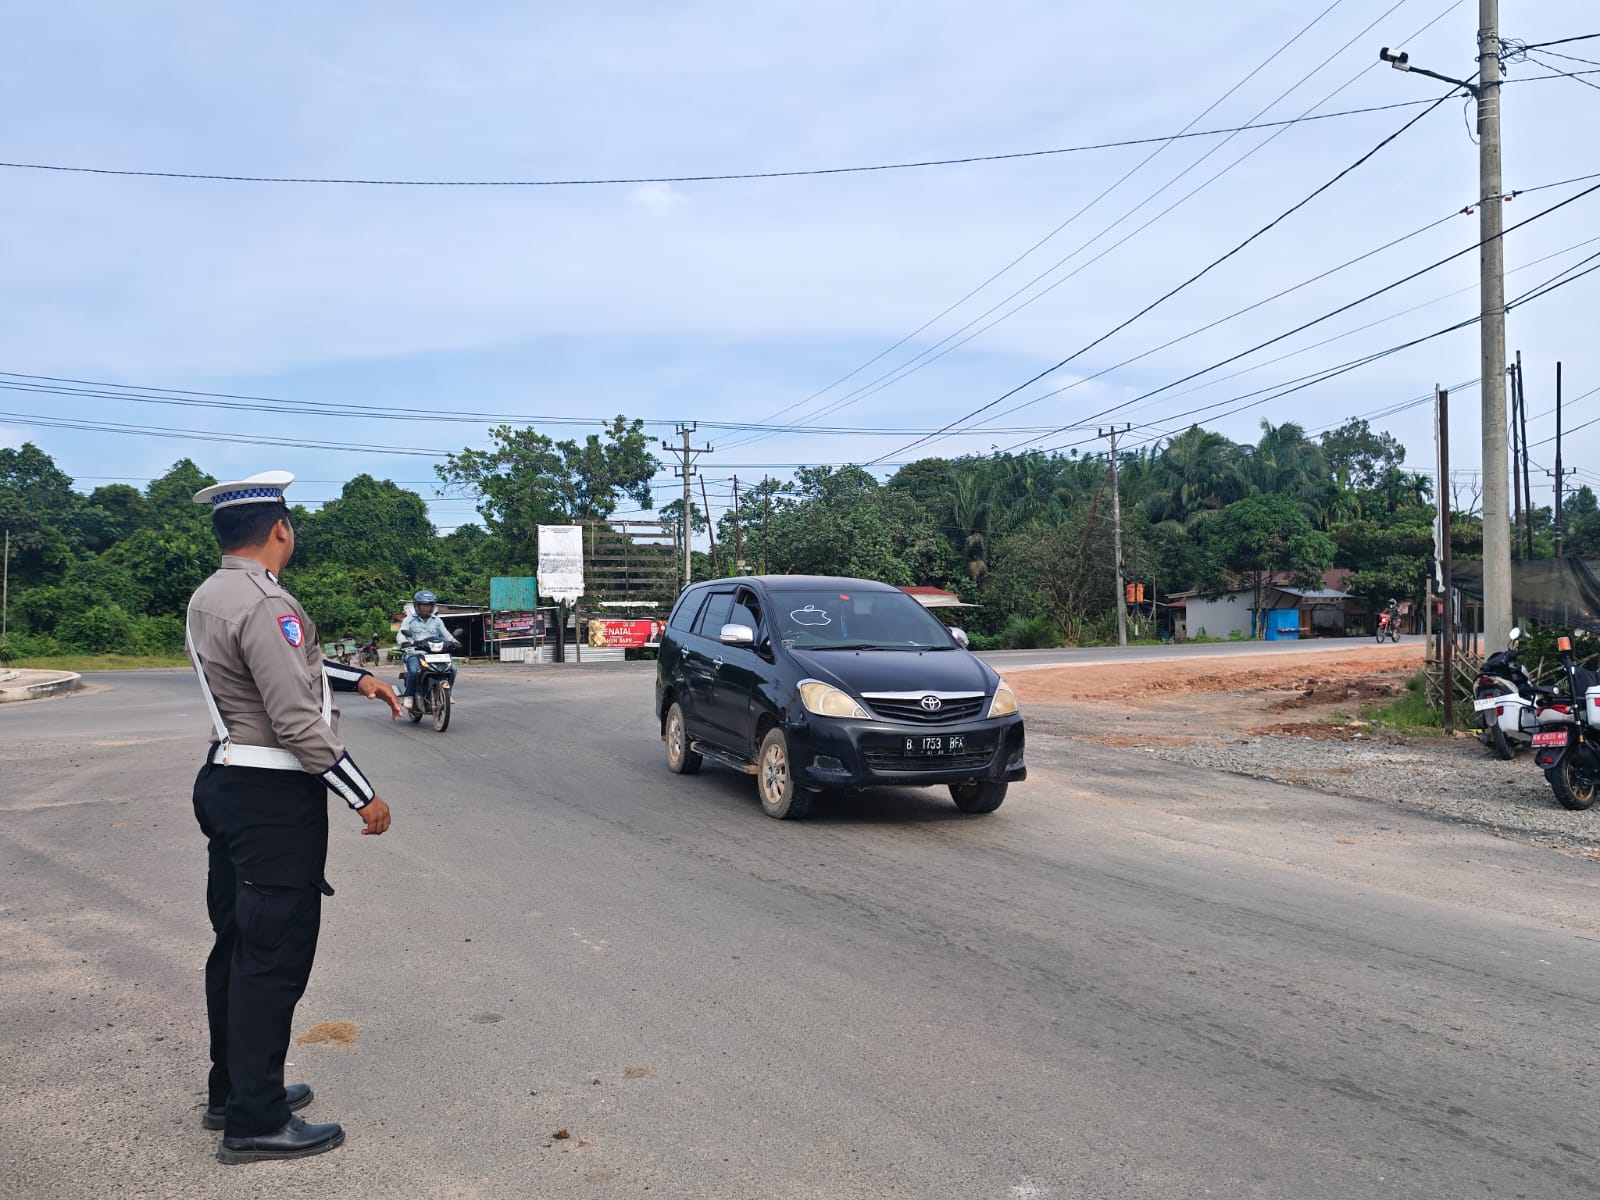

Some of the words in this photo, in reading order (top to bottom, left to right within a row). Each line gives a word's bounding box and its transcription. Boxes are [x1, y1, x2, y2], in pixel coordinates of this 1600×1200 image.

[608, 627, 631, 636] NATAL
[906, 738, 913, 750] B
[922, 737, 942, 750] 1753
